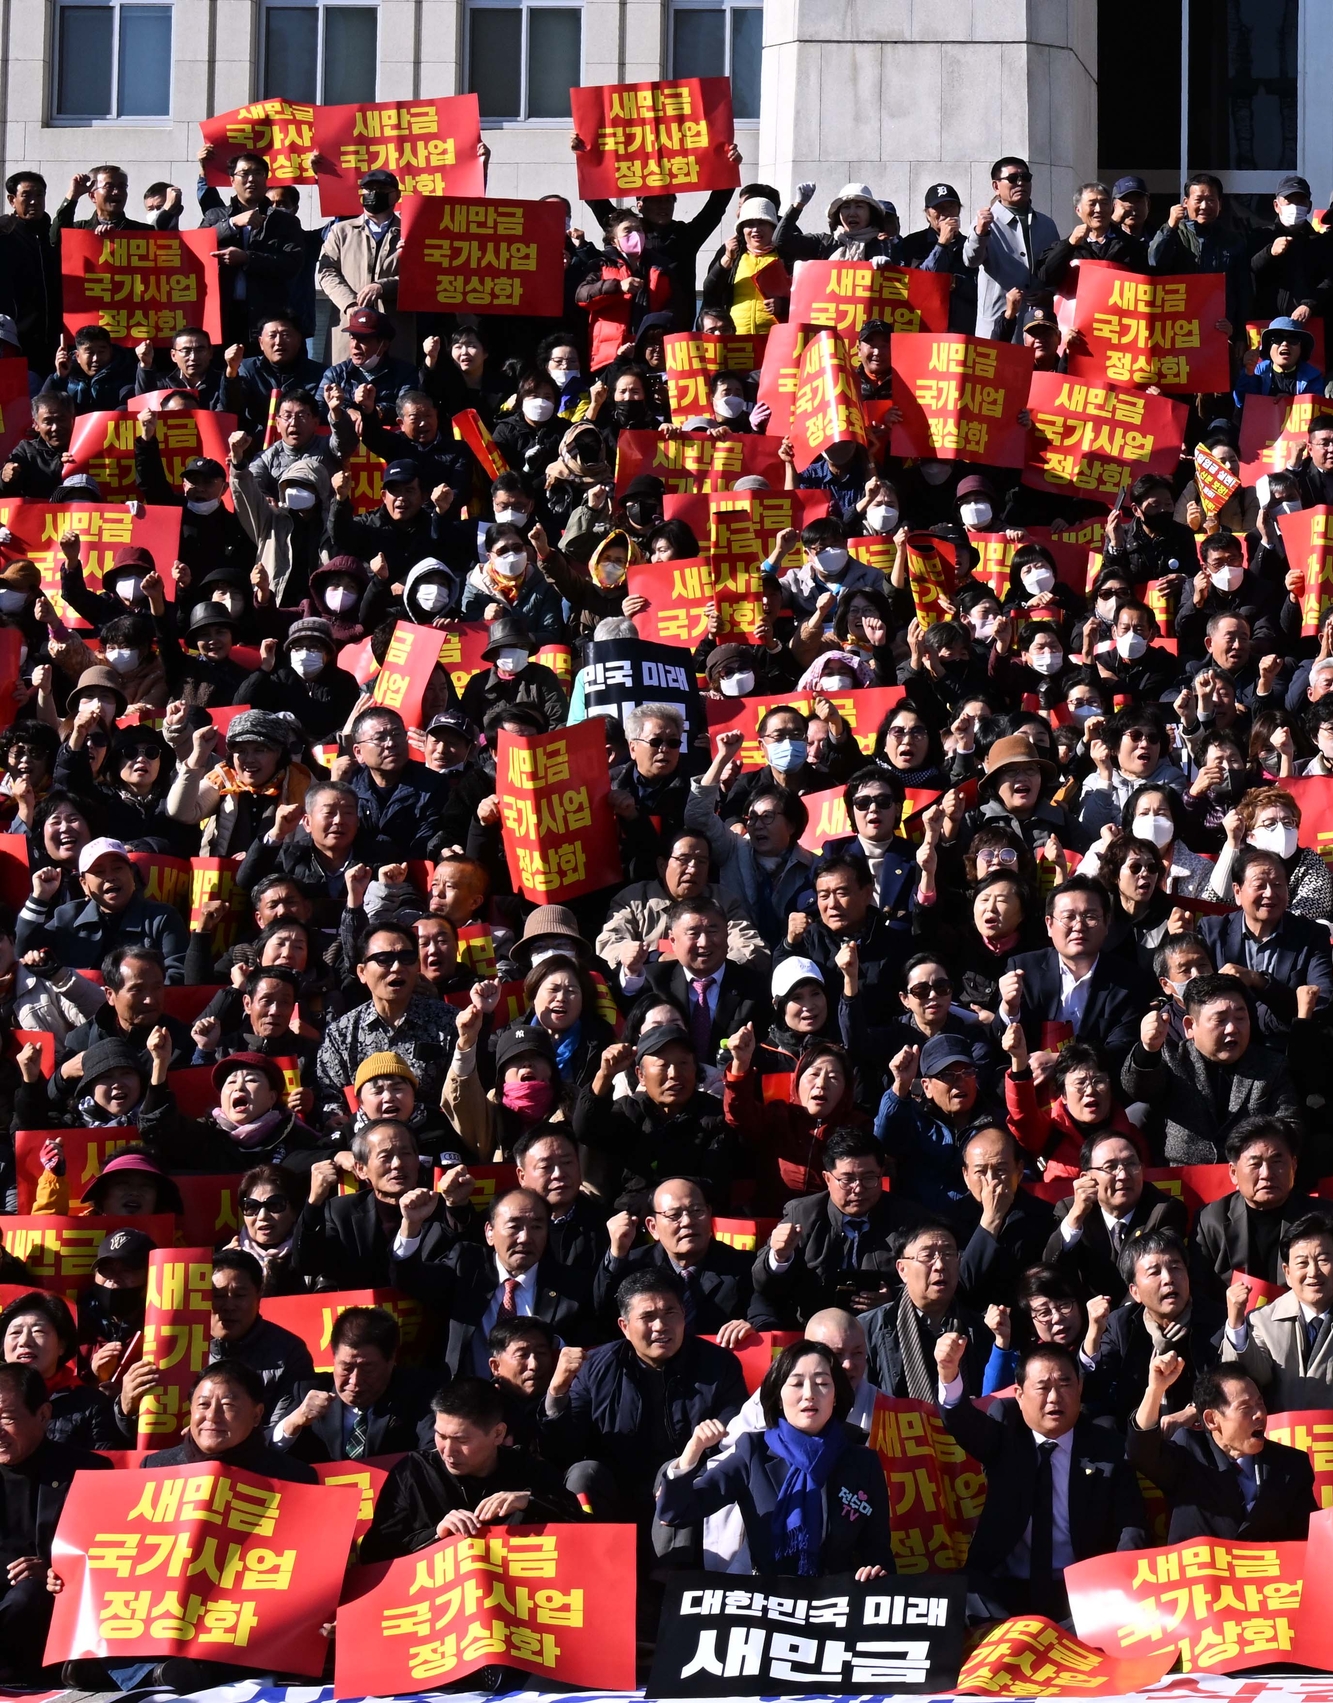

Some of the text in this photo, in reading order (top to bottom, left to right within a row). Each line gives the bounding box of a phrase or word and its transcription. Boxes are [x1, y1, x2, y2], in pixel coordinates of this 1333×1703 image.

[610, 87, 691, 119] 새만금
[226, 124, 313, 149] 국가사
[353, 107, 438, 137] 새만금
[599, 120, 708, 154] 국가사업
[341, 138, 456, 171] 국가사업
[615, 156, 699, 188] 정상화
[440, 206, 523, 235] 새만금
[99, 239, 180, 266] 새만금
[424, 240, 537, 270] 국가사업
[85, 274, 196, 302] 국가사업
[437, 276, 523, 305] 정상화
[826, 269, 908, 300] 새만금
[1108, 280, 1186, 312] 새만금
[99, 310, 186, 338] 정상화
[1093, 313, 1200, 348] 국가사업
[928, 342, 996, 378] 새만금
[1106, 351, 1189, 383] 정상화
[916, 379, 1004, 417] 국가사업
[1050, 383, 1145, 427] 새만금
[928, 417, 987, 453] 정상화
[1036, 410, 1154, 465] 국가사업
[654, 440, 742, 471] 새만금
[1044, 448, 1135, 492] 정상화
[42, 512, 133, 543] 새만금
[643, 662, 688, 690] 미래
[508, 740, 569, 789] 새만금
[503, 787, 591, 840] 국가사업
[516, 841, 585, 891] 정상화
[123, 1475, 281, 1539] 새만금
[840, 1504, 860, 1521] TV
[88, 1532, 297, 1590] 국가사업
[409, 1536, 563, 1601] 새만금
[1132, 1546, 1286, 1595] 새만금
[99, 1590, 258, 1646] 정상화
[381, 1582, 583, 1643] 국가사업
[680, 1590, 948, 1627] 대한민국 미래
[1118, 1574, 1303, 1651] 국가사업
[404, 1613, 567, 1679] 정상화
[682, 1629, 932, 1683] 새만금
